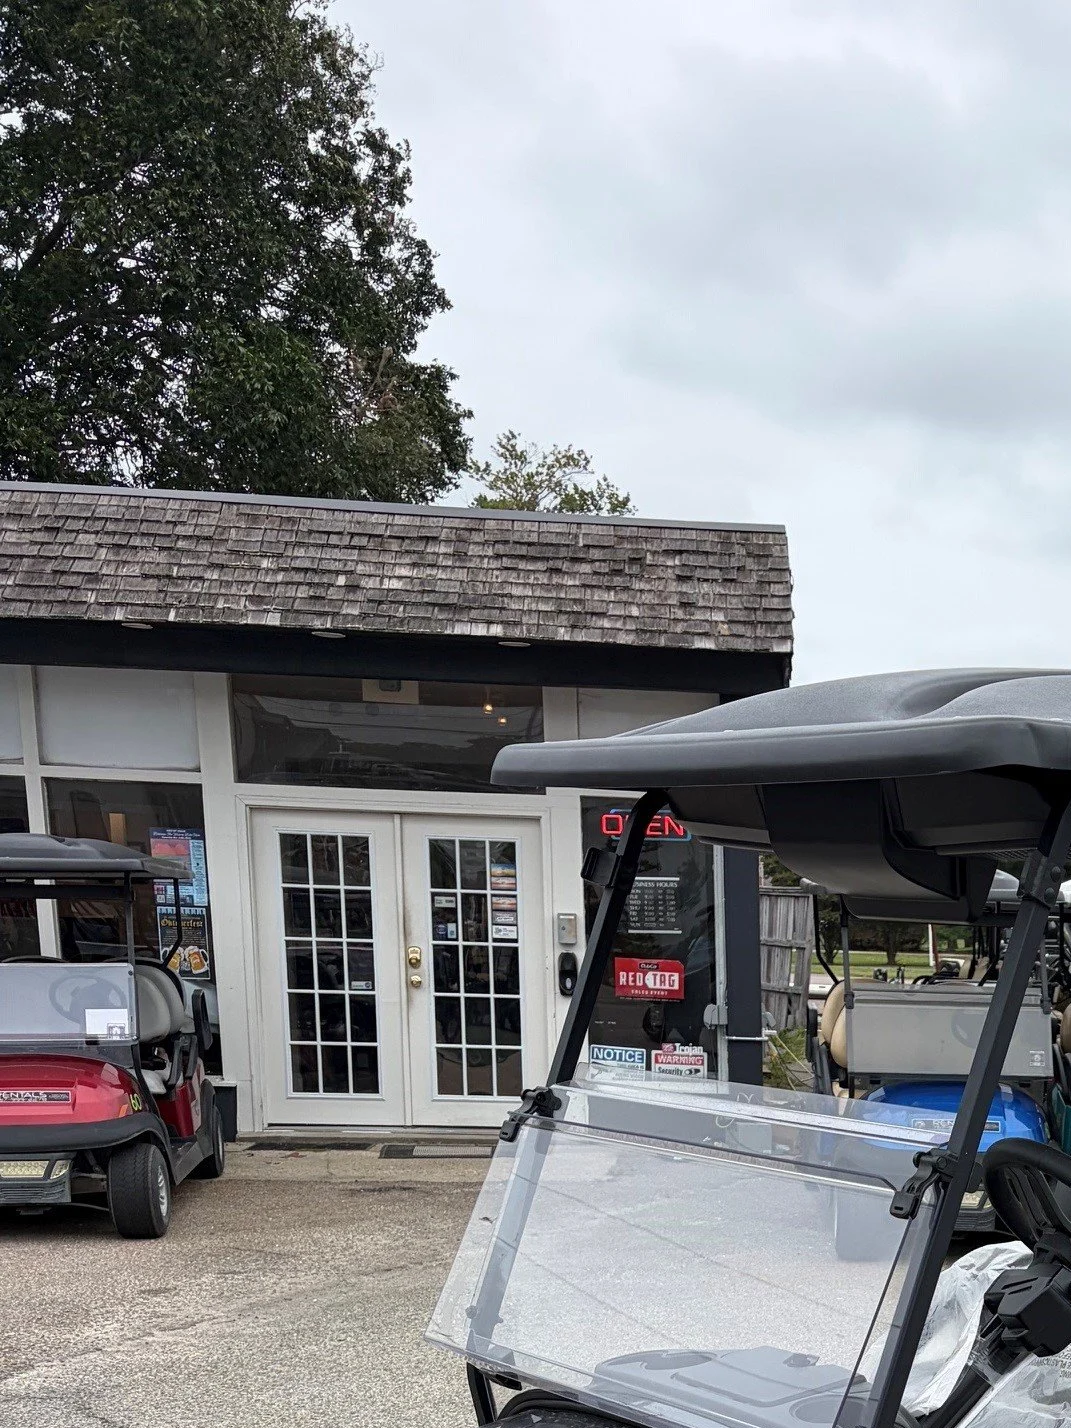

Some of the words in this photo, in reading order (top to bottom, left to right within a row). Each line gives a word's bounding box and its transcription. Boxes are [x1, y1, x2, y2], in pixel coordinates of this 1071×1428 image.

[601, 814, 685, 837] OEN
[620, 971, 644, 987] RED
[652, 973, 676, 988] TAG
[593, 1048, 643, 1064] NOTICE
[676, 1043, 704, 1056] Trojan
[657, 1055, 704, 1065] WARNING
[658, 1066, 683, 1076] Security
[0, 1091, 47, 1099] ENTALS
